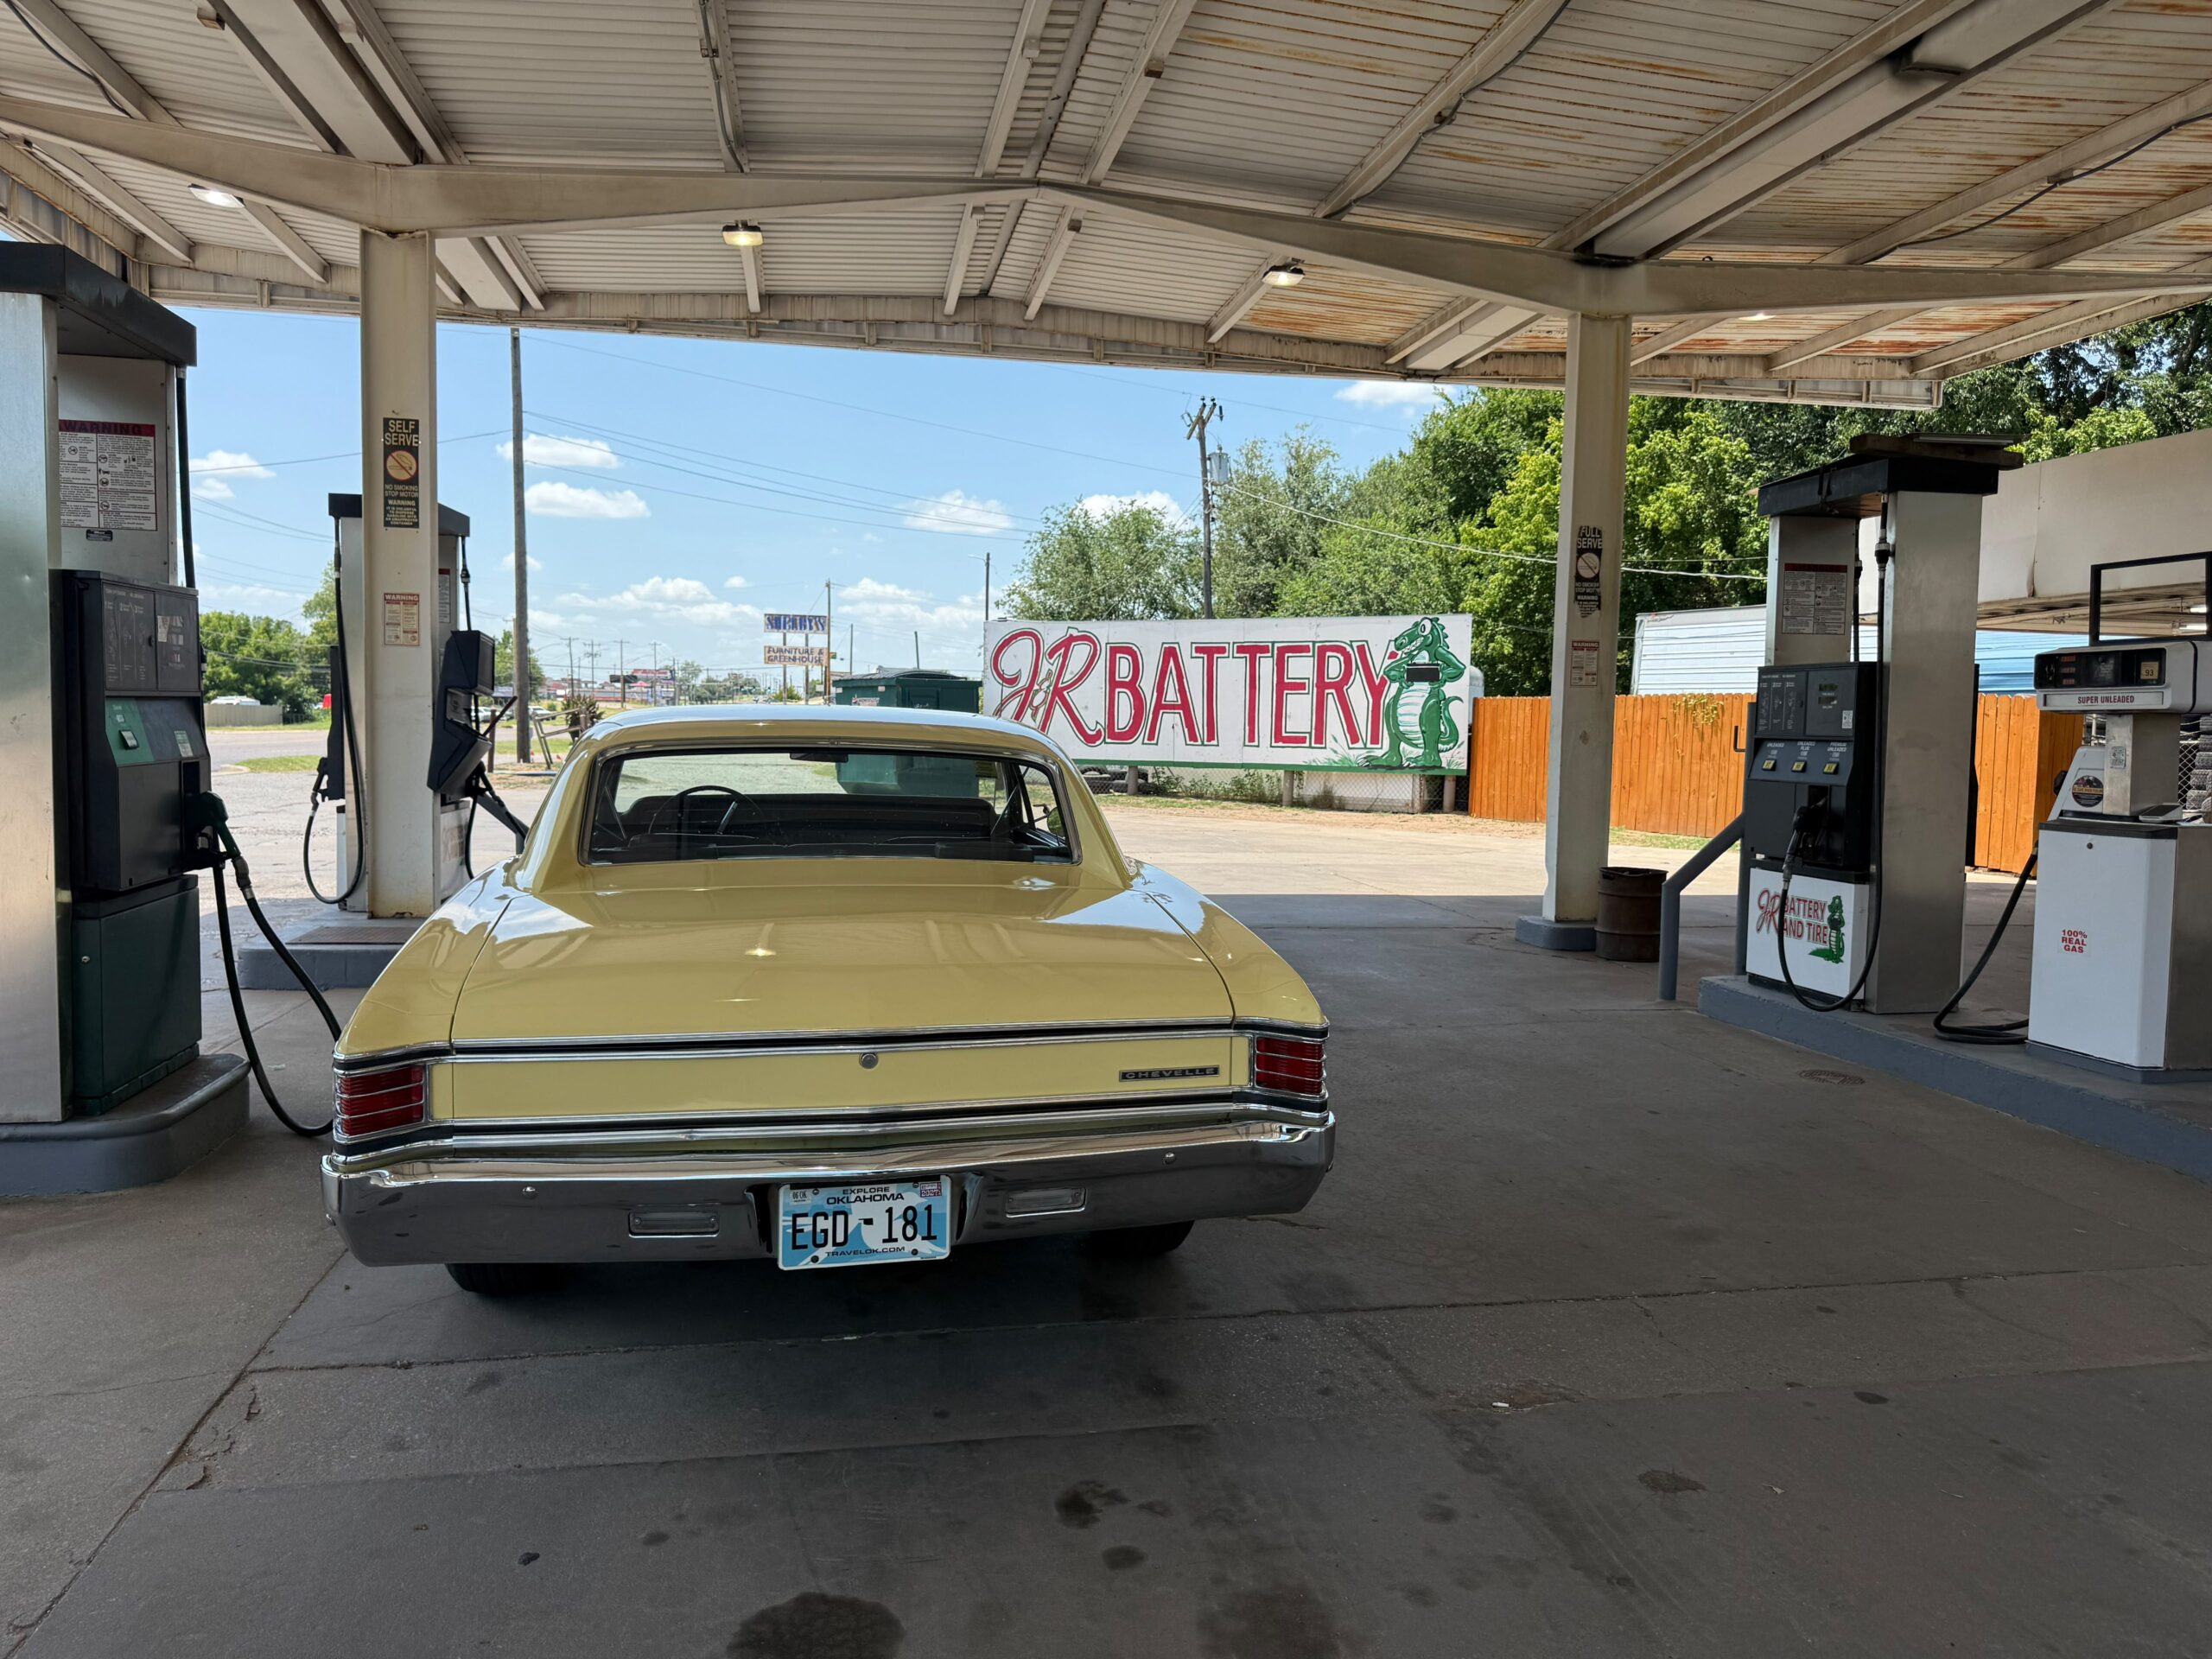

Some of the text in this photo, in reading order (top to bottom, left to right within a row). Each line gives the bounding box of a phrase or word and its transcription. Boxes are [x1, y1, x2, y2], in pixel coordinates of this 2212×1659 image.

[65, 423, 142, 435] WARNING
[389, 420, 415, 432] SELF
[385, 433, 418, 447] SERVE
[1580, 526, 1601, 537] FULL
[1577, 538, 1603, 549] SERVE
[767, 646, 815, 655] FURNITURE
[767, 655, 823, 664] GREENHOUSE
[1104, 640, 1397, 749] BATTERY
[2077, 695, 2135, 704] SUPER UNLEADED
[1783, 916, 1829, 945] AND TIRE
[2062, 929, 2088, 938] 100%
[2061, 937, 2088, 946] REAL
[2063, 944, 2084, 953] GAS
[1125, 1068, 1215, 1078] CHEVELLE
[842, 1186, 890, 1195] EXPLORE
[826, 1192, 905, 1205] OKLAHOMA
[791, 1205, 937, 1250] EGD 181
[825, 1246, 906, 1257] TRAVELOK.COM
